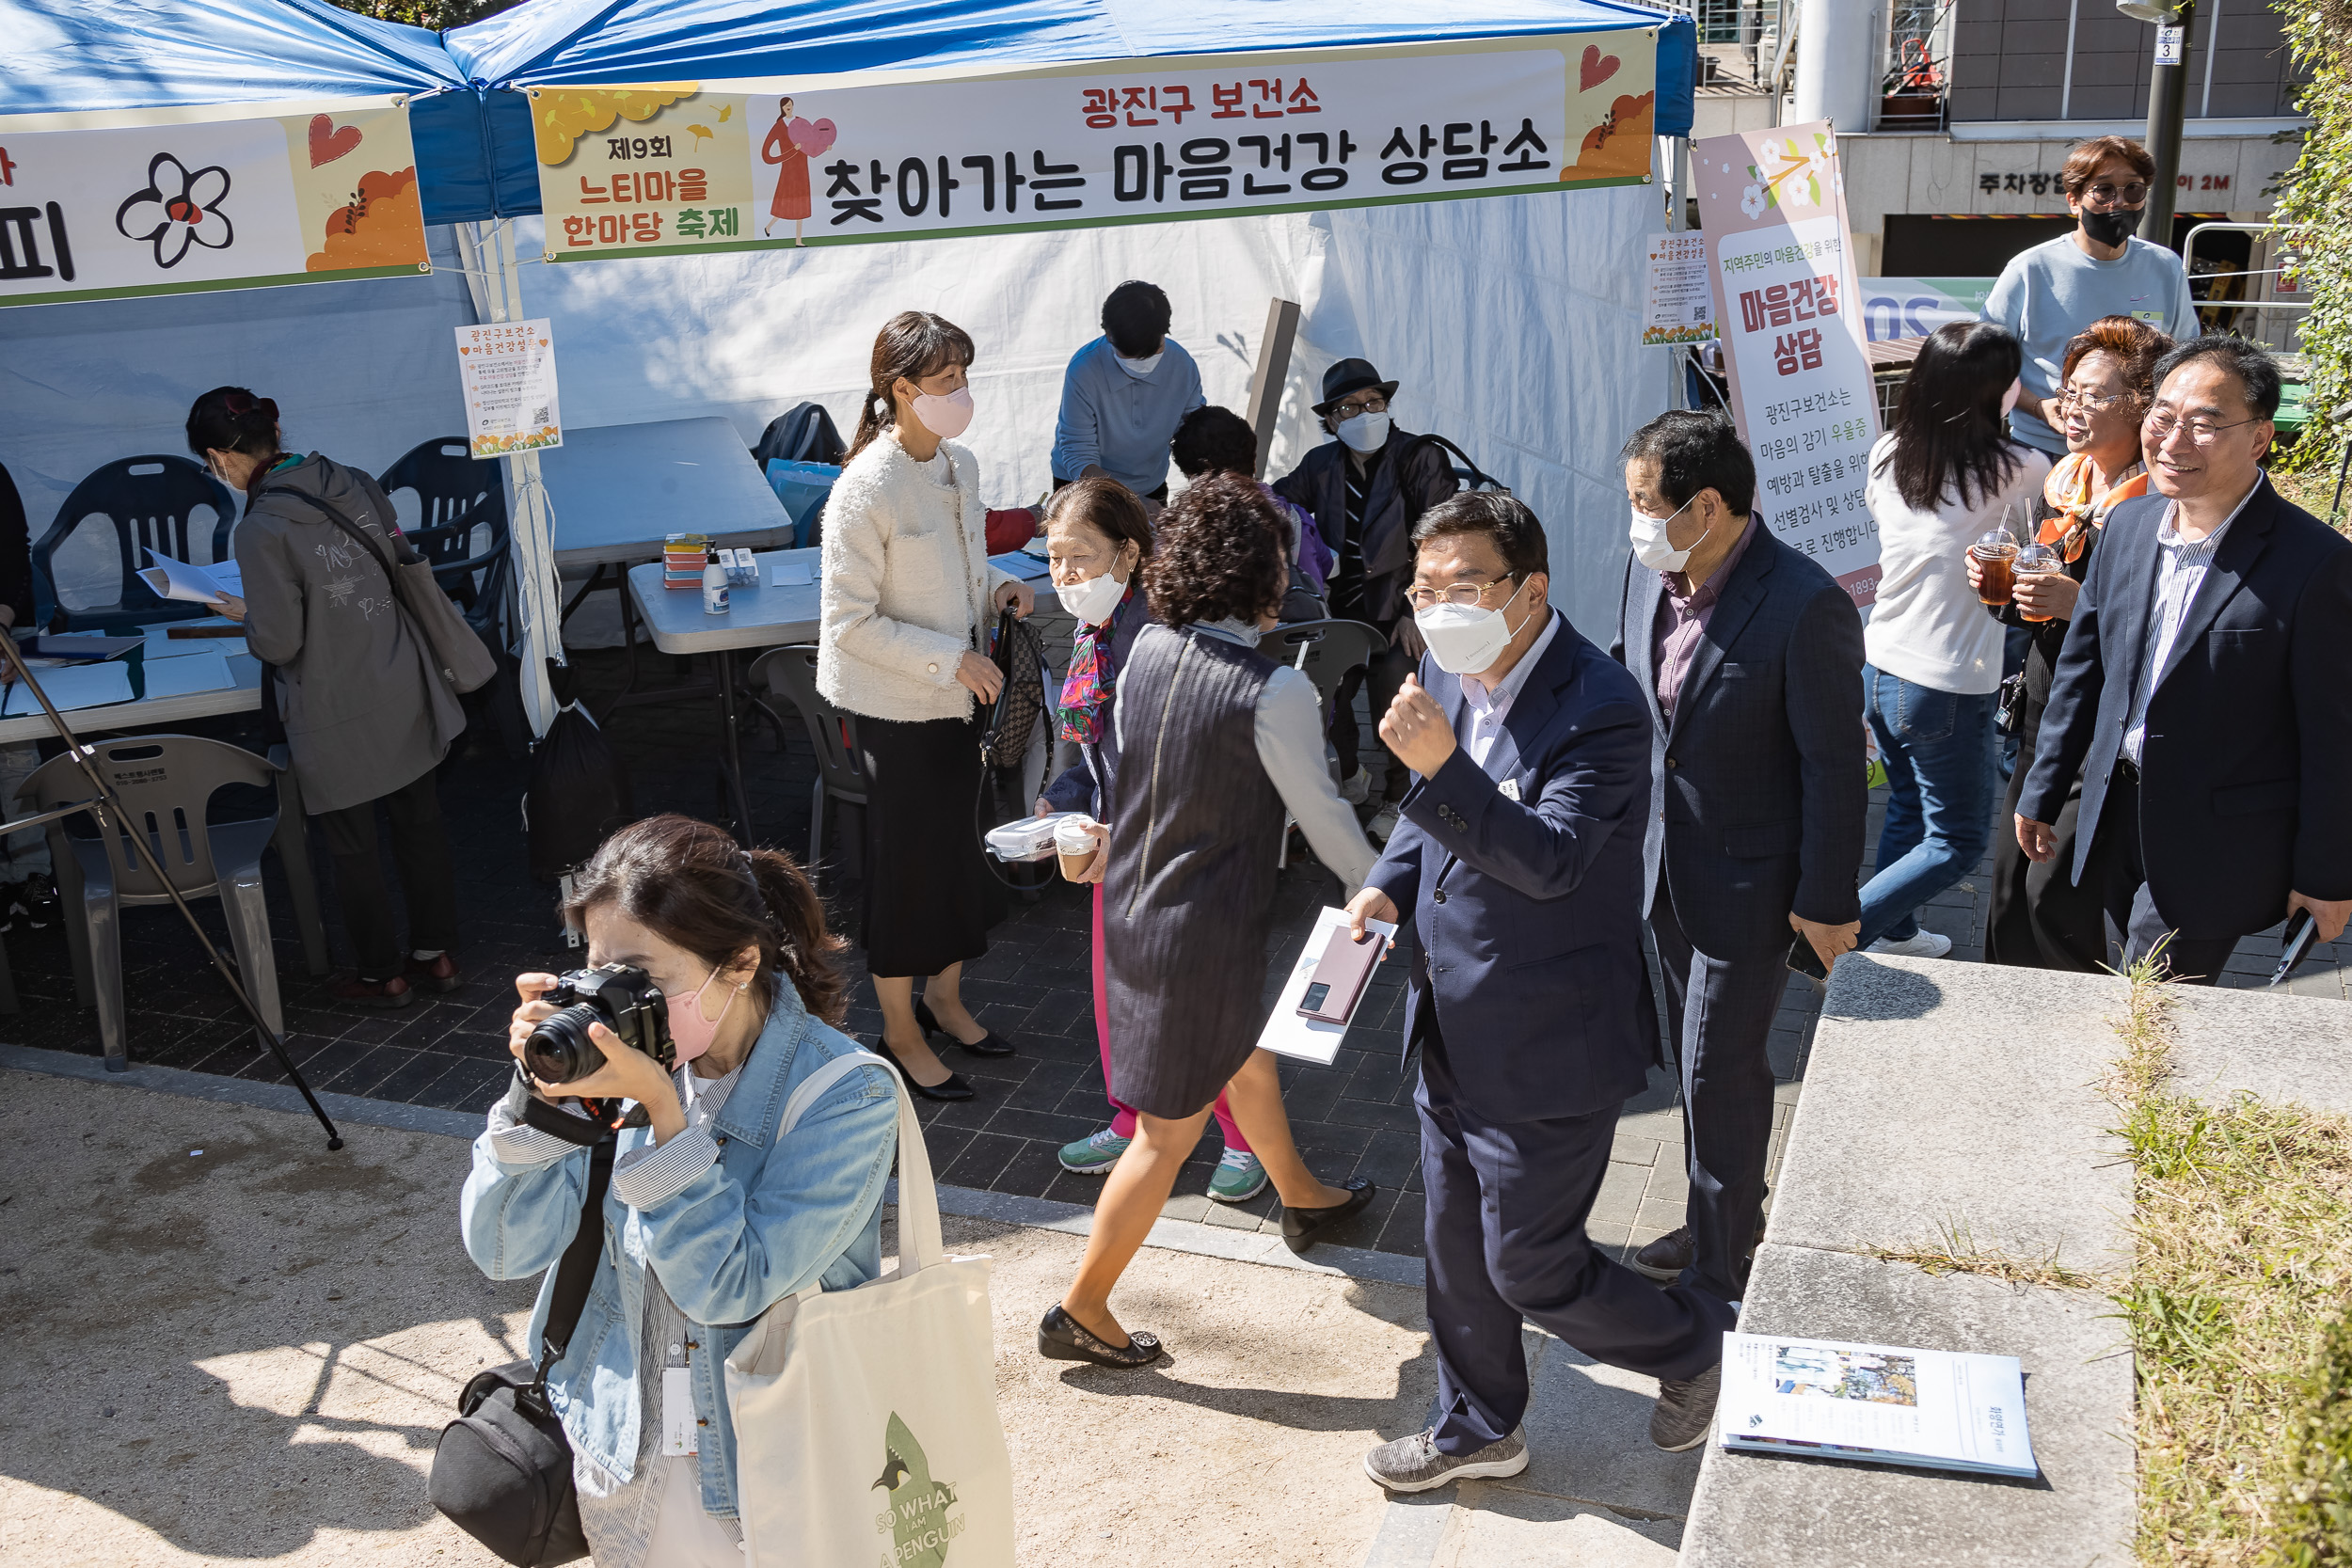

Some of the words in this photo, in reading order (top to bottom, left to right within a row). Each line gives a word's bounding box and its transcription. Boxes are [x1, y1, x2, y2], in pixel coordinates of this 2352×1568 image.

[2162, 44, 2170, 57] 3
[1082, 85, 1197, 129] 광진구
[1211, 77, 1322, 119] 보건소
[607, 135, 673, 160] 제9회
[580, 167, 708, 204] 느티마을
[823, 149, 1087, 226] 찾아가는
[1113, 129, 1357, 202] 마음건강
[1379, 117, 1551, 185] 상담소
[2201, 175, 2230, 190] 2M
[563, 212, 663, 247] 한마당
[675, 207, 739, 239] 축제
[1724, 251, 1773, 275] 지역주민의
[1774, 241, 1822, 264] 마음건강을
[1824, 237, 1841, 256] 위한
[1740, 274, 1838, 333] 마음건강
[470, 326, 535, 341] 광진구보건소
[1773, 327, 1823, 376] 상담
[1765, 388, 1851, 426] 광진구보건소는
[1760, 435, 1799, 461] 마음의
[1803, 428, 1827, 451] 감기
[1831, 418, 1867, 443] 우울증
[1767, 469, 1804, 496] 예방과
[1808, 459, 1845, 486] 탈출을
[1773, 499, 1823, 532] 선별검사
[1826, 496, 1839, 516] 및
[875, 1509, 898, 1534] SO
[898, 1481, 957, 1521] WHAT
[905, 1523, 911, 1533] I
[911, 1515, 927, 1531] AM
[893, 1513, 966, 1567] PENGUIN
